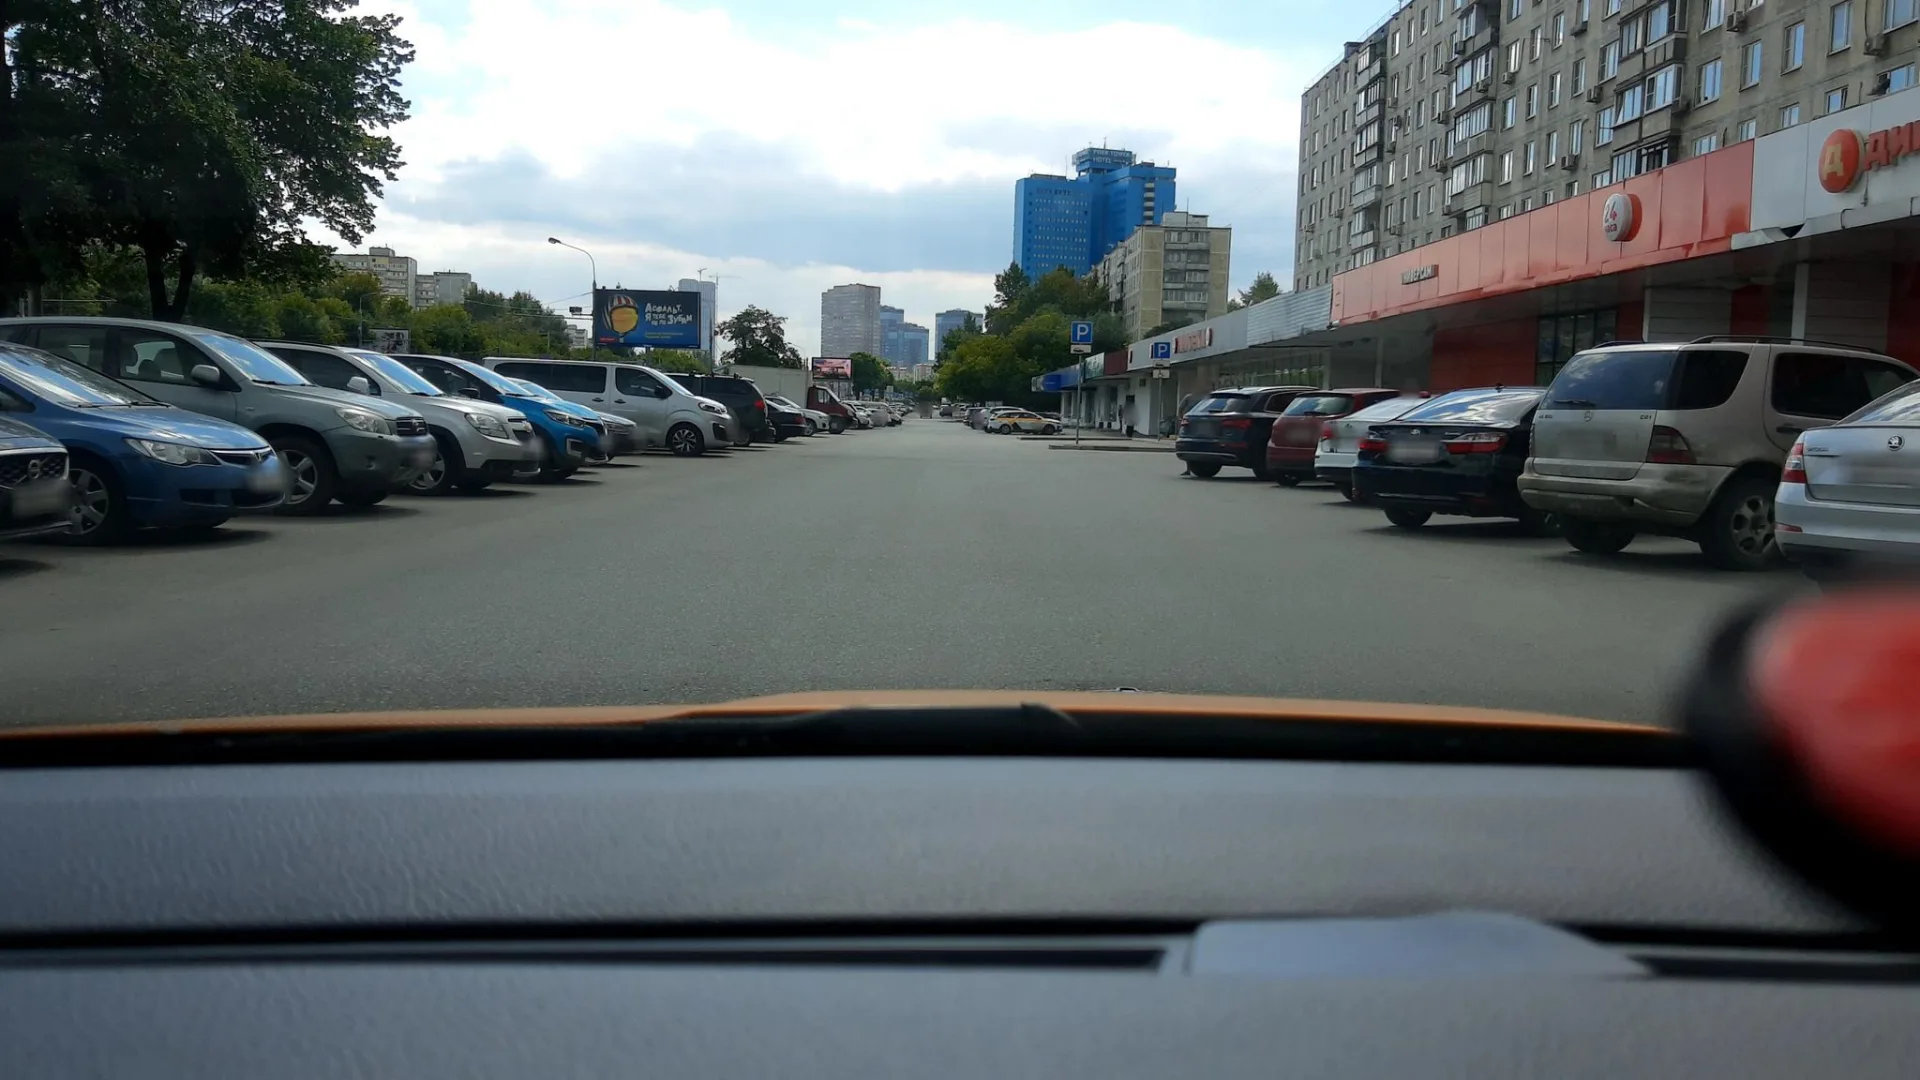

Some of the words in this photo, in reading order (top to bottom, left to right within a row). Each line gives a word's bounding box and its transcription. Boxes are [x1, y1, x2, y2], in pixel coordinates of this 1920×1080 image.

[1864, 119, 1920, 172] ДИ
[1604, 200, 1618, 224] 24
[1076, 324, 1089, 341] P
[1158, 344, 1168, 357] P
